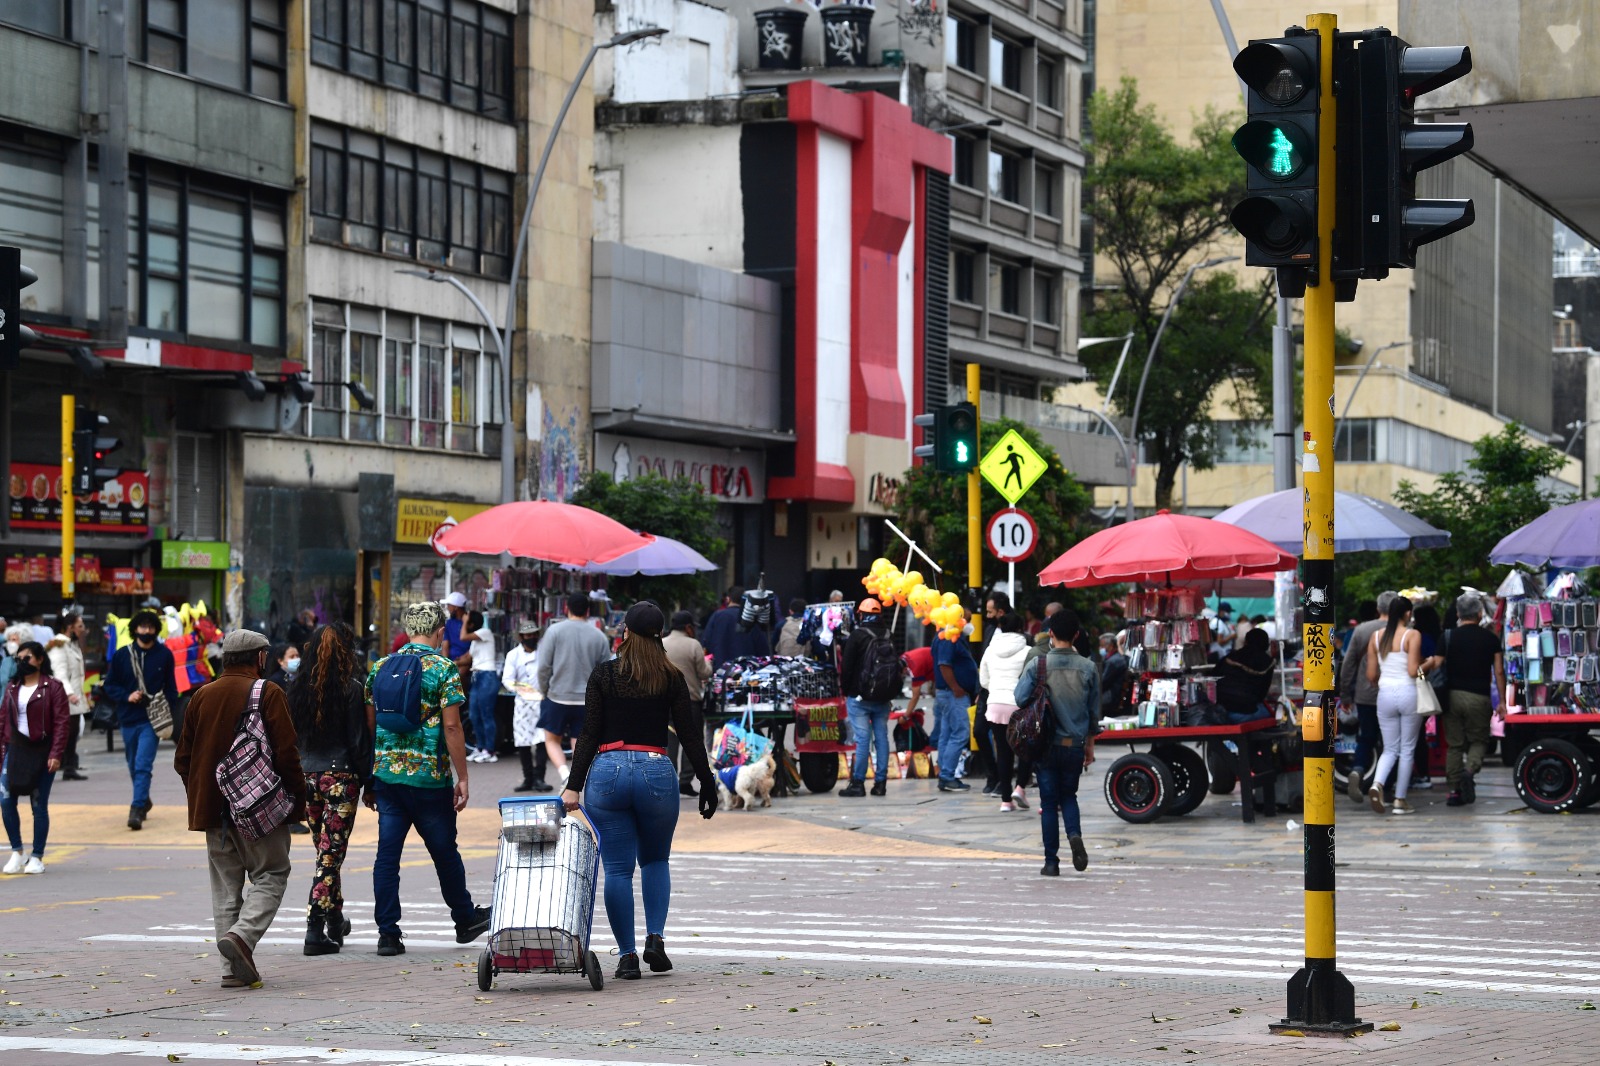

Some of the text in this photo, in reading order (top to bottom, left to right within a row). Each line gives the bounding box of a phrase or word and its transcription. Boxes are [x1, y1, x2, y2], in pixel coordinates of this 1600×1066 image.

[999, 523, 1025, 547] 10
[809, 706, 838, 721] BOXER
[810, 726, 839, 740] MEDIAS
